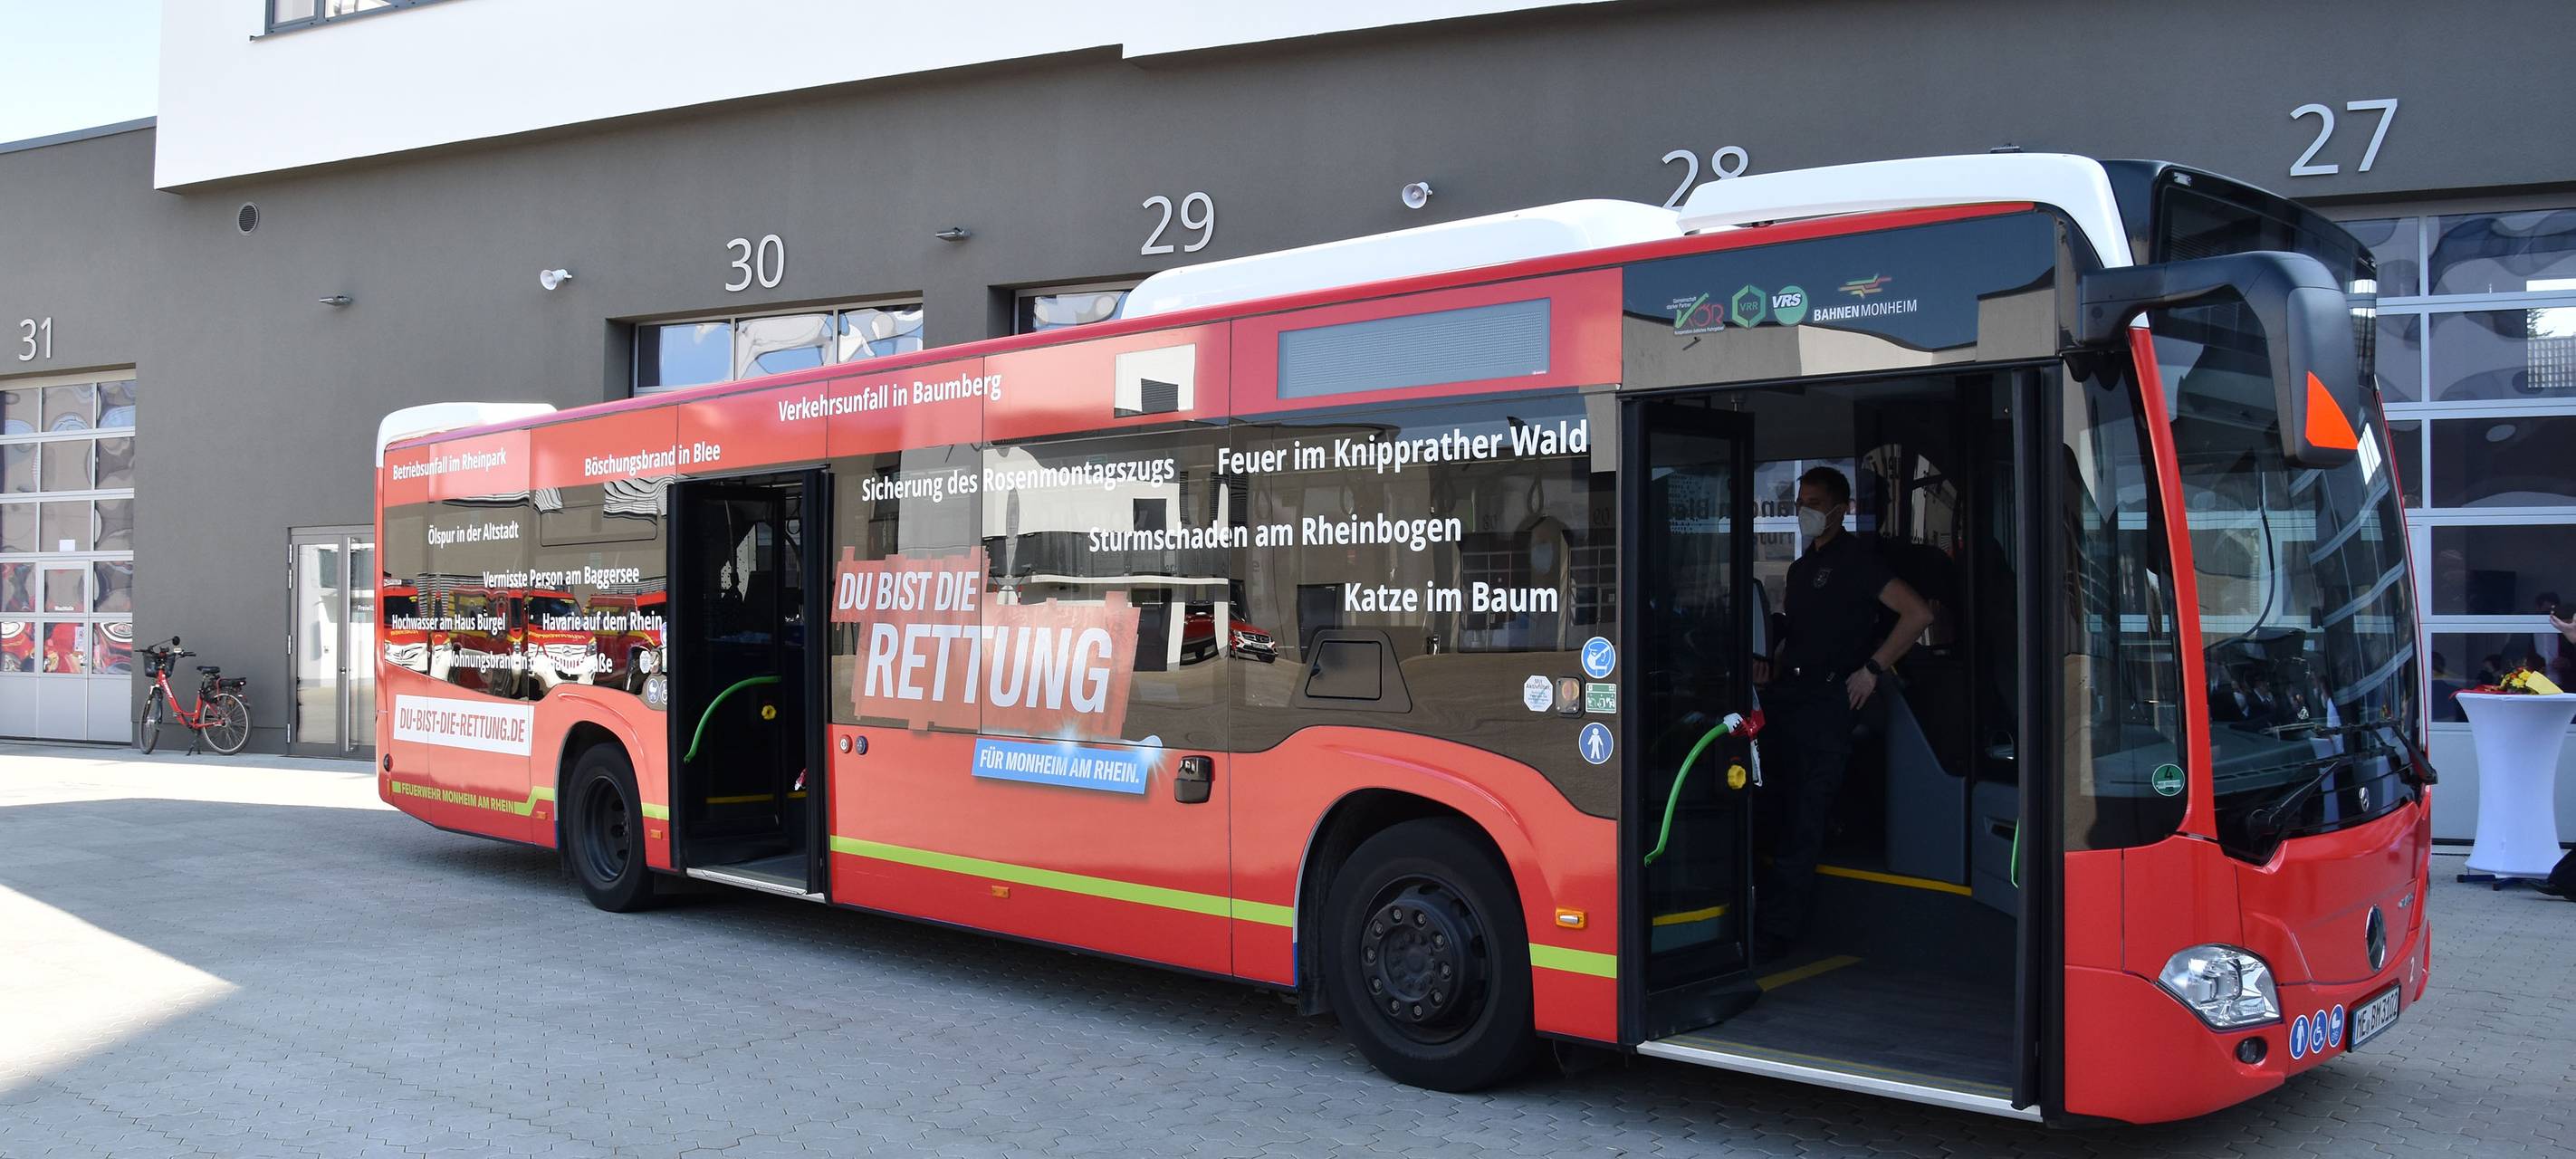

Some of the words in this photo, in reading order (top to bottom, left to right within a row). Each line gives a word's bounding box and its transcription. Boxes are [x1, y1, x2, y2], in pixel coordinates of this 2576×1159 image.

[2290, 99, 2398, 177] 27
[1141, 192, 1214, 255] 29
[724, 234, 784, 292] 30
[1739, 301, 1758, 311] VRR
[1772, 292, 1802, 310] VRS
[19, 317, 53, 362] 31
[779, 387, 888, 422] Verkehrsunfall
[893, 385, 907, 406] in
[913, 373, 1002, 405] Baumberg
[393, 456, 447, 480] Betriebsunfall
[449, 455, 460, 471] im
[462, 448, 506, 469] Rheinpark
[585, 445, 675, 476] Böschungsbrand
[678, 447, 690, 464] in
[693, 441, 721, 463] Blee
[1217, 445, 1287, 476] Feuer
[1293, 440, 1326, 471] im
[1334, 429, 1506, 474] Knipprather
[1510, 419, 1587, 457] Wald
[862, 474, 943, 503] Sicherung
[948, 468, 977, 495] des
[983, 457, 1174, 492] Rosenmontagszugs
[428, 524, 455, 548] Ölspur
[456, 525, 465, 542] in
[467, 523, 482, 541] der
[483, 521, 519, 541] Altstadt
[1089, 522, 1249, 553] Sturmschaden
[1256, 523, 1292, 548] am
[1302, 512, 1461, 551] Rheinbogen
[484, 570, 527, 589] Vermisste
[530, 569, 562, 588] Person
[565, 570, 581, 585] am
[584, 565, 639, 589] Baggersee
[838, 572, 873, 610] DU
[876, 571, 932, 610] BIST
[934, 570, 980, 611] DIE
[1344, 582, 1418, 613] Katze
[1425, 580, 1462, 612] im
[1471, 580, 1557, 613] Baum
[392, 614, 437, 631] Hochwasser
[439, 617, 453, 631] am
[455, 613, 475, 631] Haus
[477, 608, 506, 636] Bürgel
[542, 611, 580, 632] Havarie
[582, 610, 601, 631] auf
[602, 610, 627, 631] dem
[629, 609, 662, 632] Rhein
[864, 623, 1113, 714] RETTUNG
[400, 707, 525, 743] DU-BIST-DIE-RETTUNG.DE
[980, 747, 1004, 770] FÜR
[1006, 752, 1067, 777] MONHEIM
[1068, 757, 1091, 778] AM
[1094, 760, 1140, 785] RHEIN.
[2164, 766, 2174, 781] 4
[401, 782, 441, 800] FEUERWEHR
[442, 789, 477, 807] MONHEIM
[478, 796, 490, 809] AM
[491, 800, 514, 814] RHEIN
